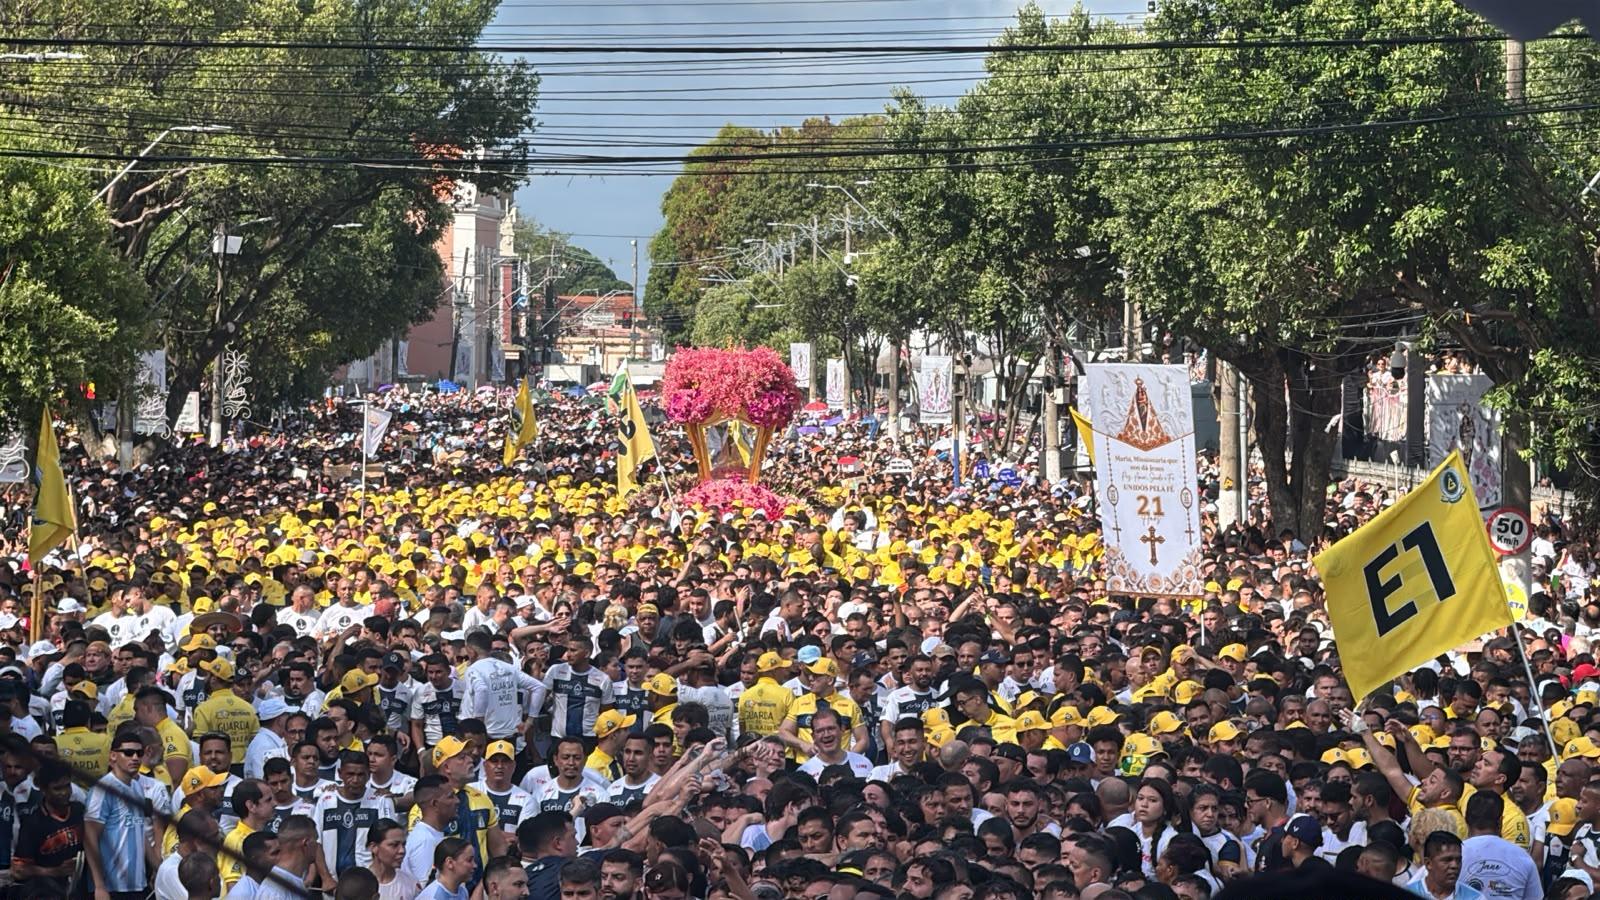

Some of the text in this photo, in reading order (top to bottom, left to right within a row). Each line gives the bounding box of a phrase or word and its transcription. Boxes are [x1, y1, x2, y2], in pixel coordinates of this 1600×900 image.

[1123, 483, 1149, 491] UNIDOS
[1149, 484, 1166, 492] PELA
[1136, 494, 1165, 516] 21
[1496, 517, 1524, 536] 50
[1496, 534, 1519, 546] Km/h
[1362, 519, 1457, 638] E1
[745, 711, 773, 720] GUARDA
[217, 720, 250, 732] GUARDA
[72, 760, 100, 770] ARDA
[1516, 821, 1526, 831] E1
